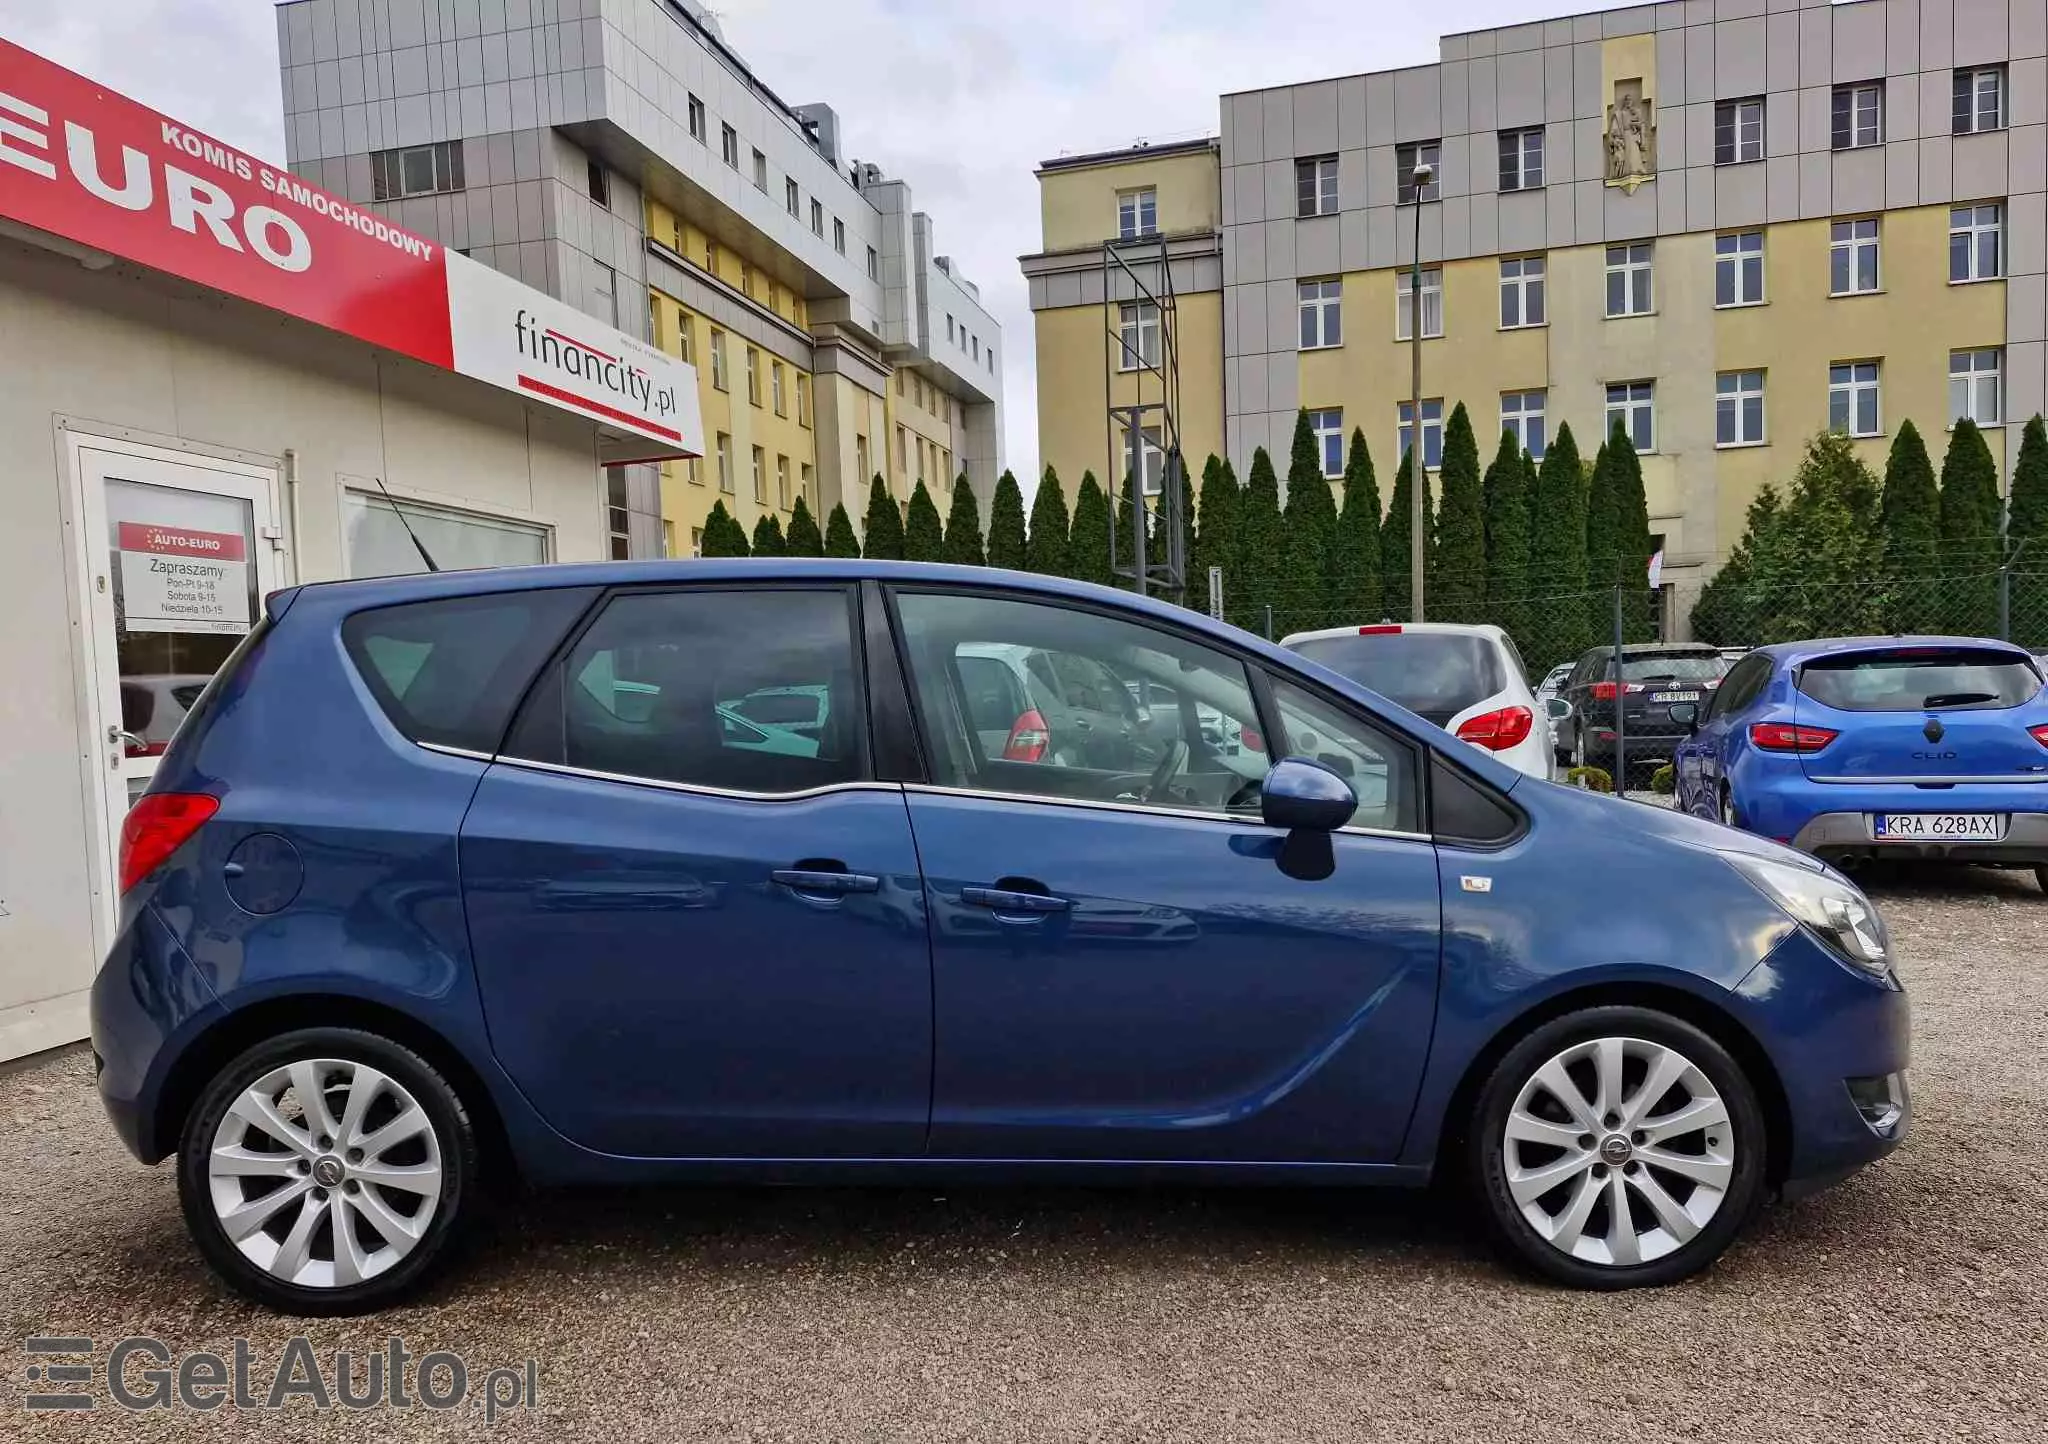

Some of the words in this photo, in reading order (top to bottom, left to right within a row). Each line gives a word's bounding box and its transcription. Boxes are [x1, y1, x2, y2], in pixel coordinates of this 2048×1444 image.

[0, 92, 312, 273] EURO
[161, 120, 253, 180] KOMIS
[260, 170, 433, 262] SAMOCHODOWY
[515, 310, 676, 416] financity.pl
[154, 534, 221, 551] AUTO-EURO
[150, 559, 224, 580] Zapraszamy
[167, 591, 197, 602] Sobota
[1911, 752, 1957, 760] CLIO
[1887, 816, 1925, 833] KRA
[1932, 816, 1993, 834] 628AX
